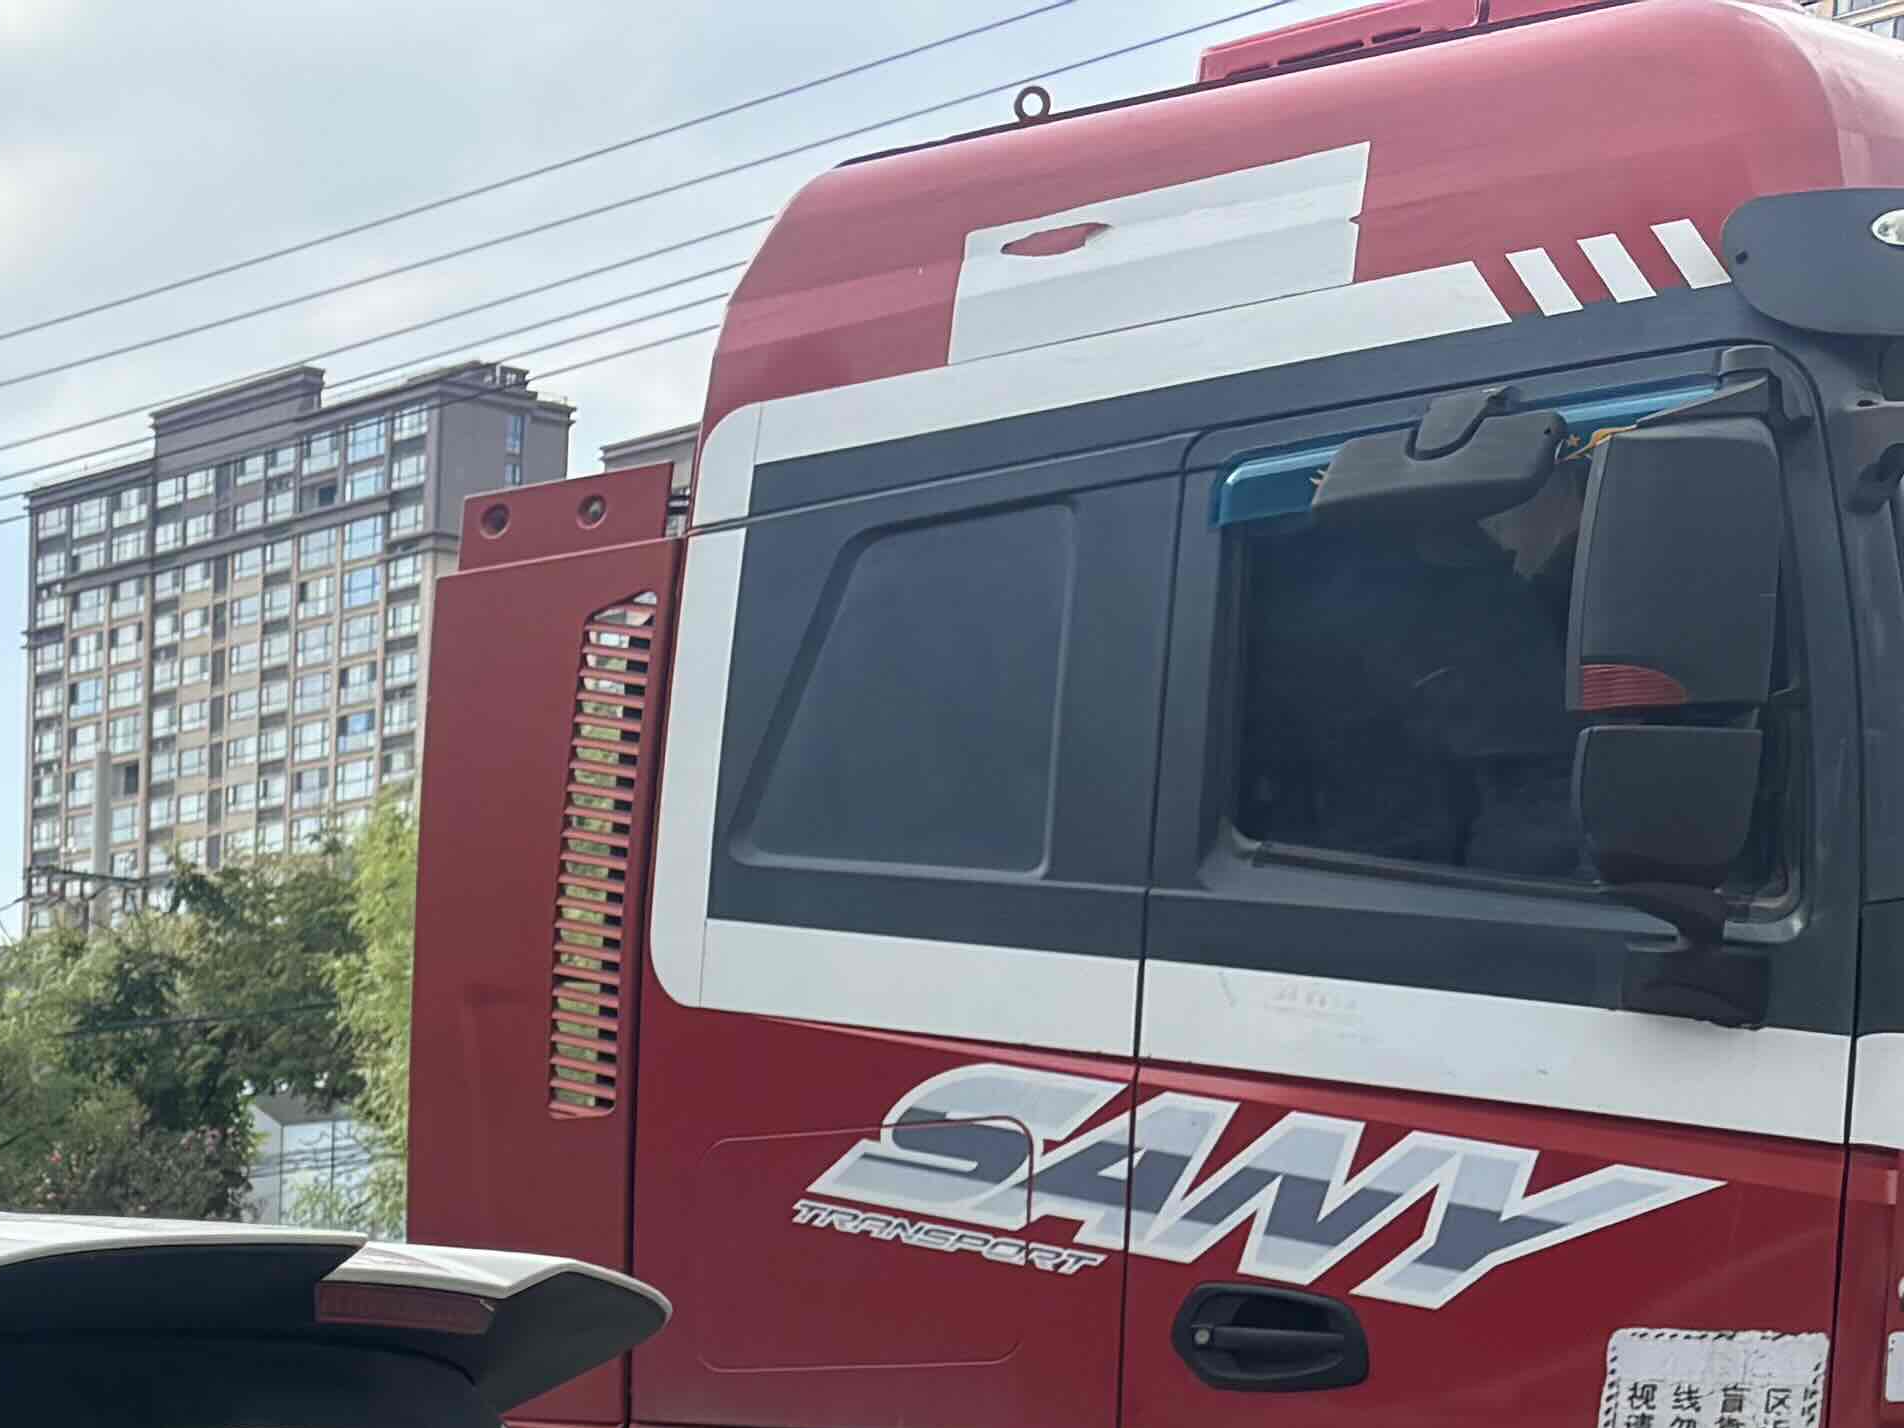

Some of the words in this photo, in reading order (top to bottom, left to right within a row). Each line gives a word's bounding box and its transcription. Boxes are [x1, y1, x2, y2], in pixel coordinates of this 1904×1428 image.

[806, 1062, 1728, 1310] SANY
[792, 1198, 1109, 1275] TRANSPORT
[1628, 1382, 1793, 1416] 视线盲区
